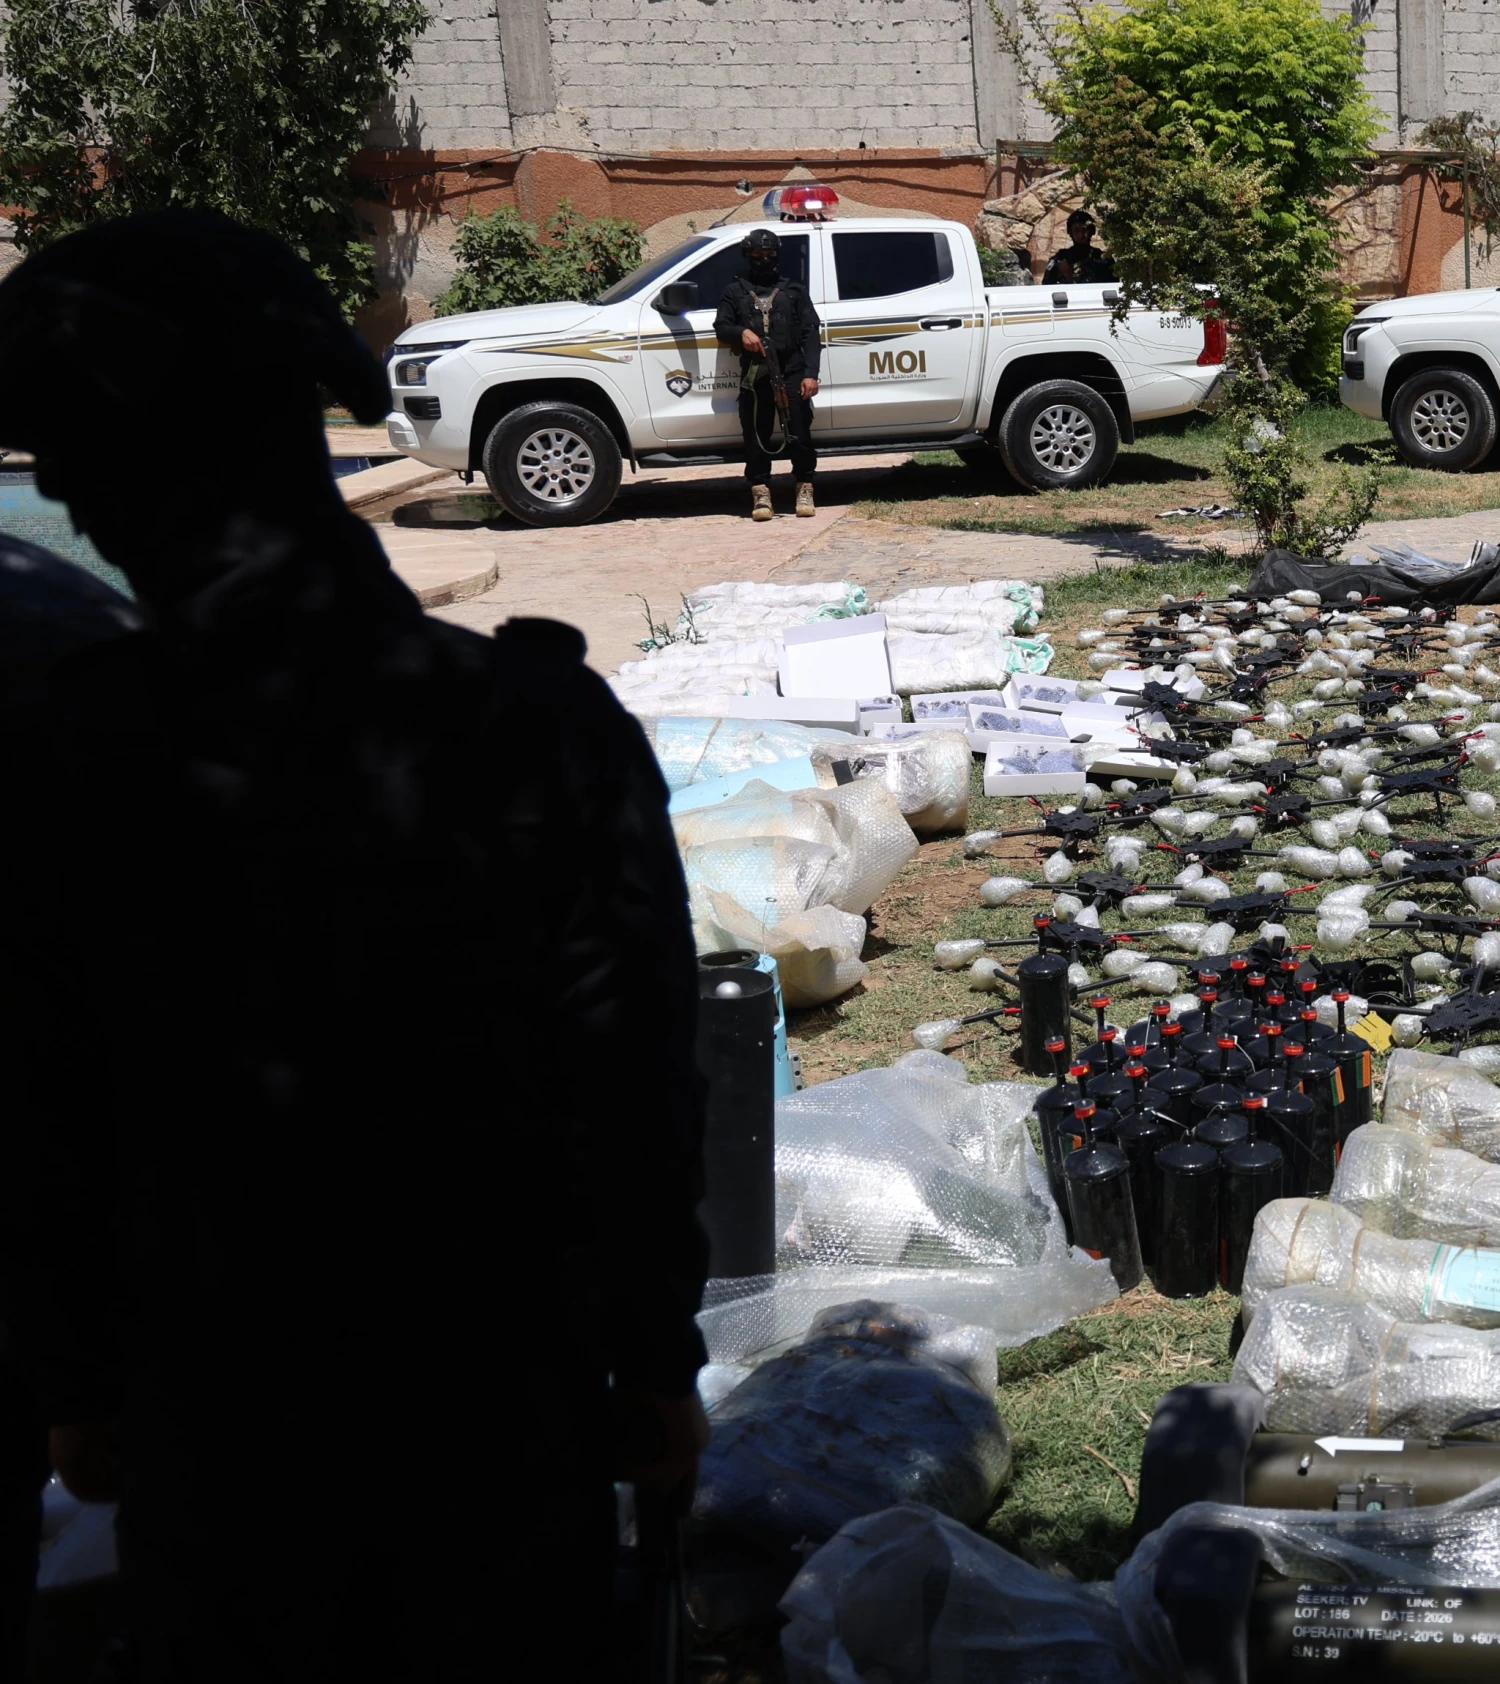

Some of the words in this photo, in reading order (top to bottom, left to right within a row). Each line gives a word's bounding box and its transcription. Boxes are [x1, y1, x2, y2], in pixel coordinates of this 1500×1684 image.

[869, 350, 926, 374] MOI
[698, 382, 738, 390] INTERNAL
[1377, 1587, 1425, 1595] MISSILE
[1296, 1594, 1349, 1605] SEEKER:
[1352, 1596, 1369, 1605] TV
[1406, 1598, 1438, 1608] LINK:
[1444, 1598, 1463, 1608] OF
[1294, 1607, 1320, 1618] LOT
[1381, 1610, 1415, 1622] DATE
[1424, 1612, 1453, 1623] 2026
[1292, 1626, 1364, 1639] OPERATION
[1366, 1627, 1402, 1640] TEMP
[1452, 1632, 1465, 1643] to
[1323, 1646, 1340, 1658] 39
